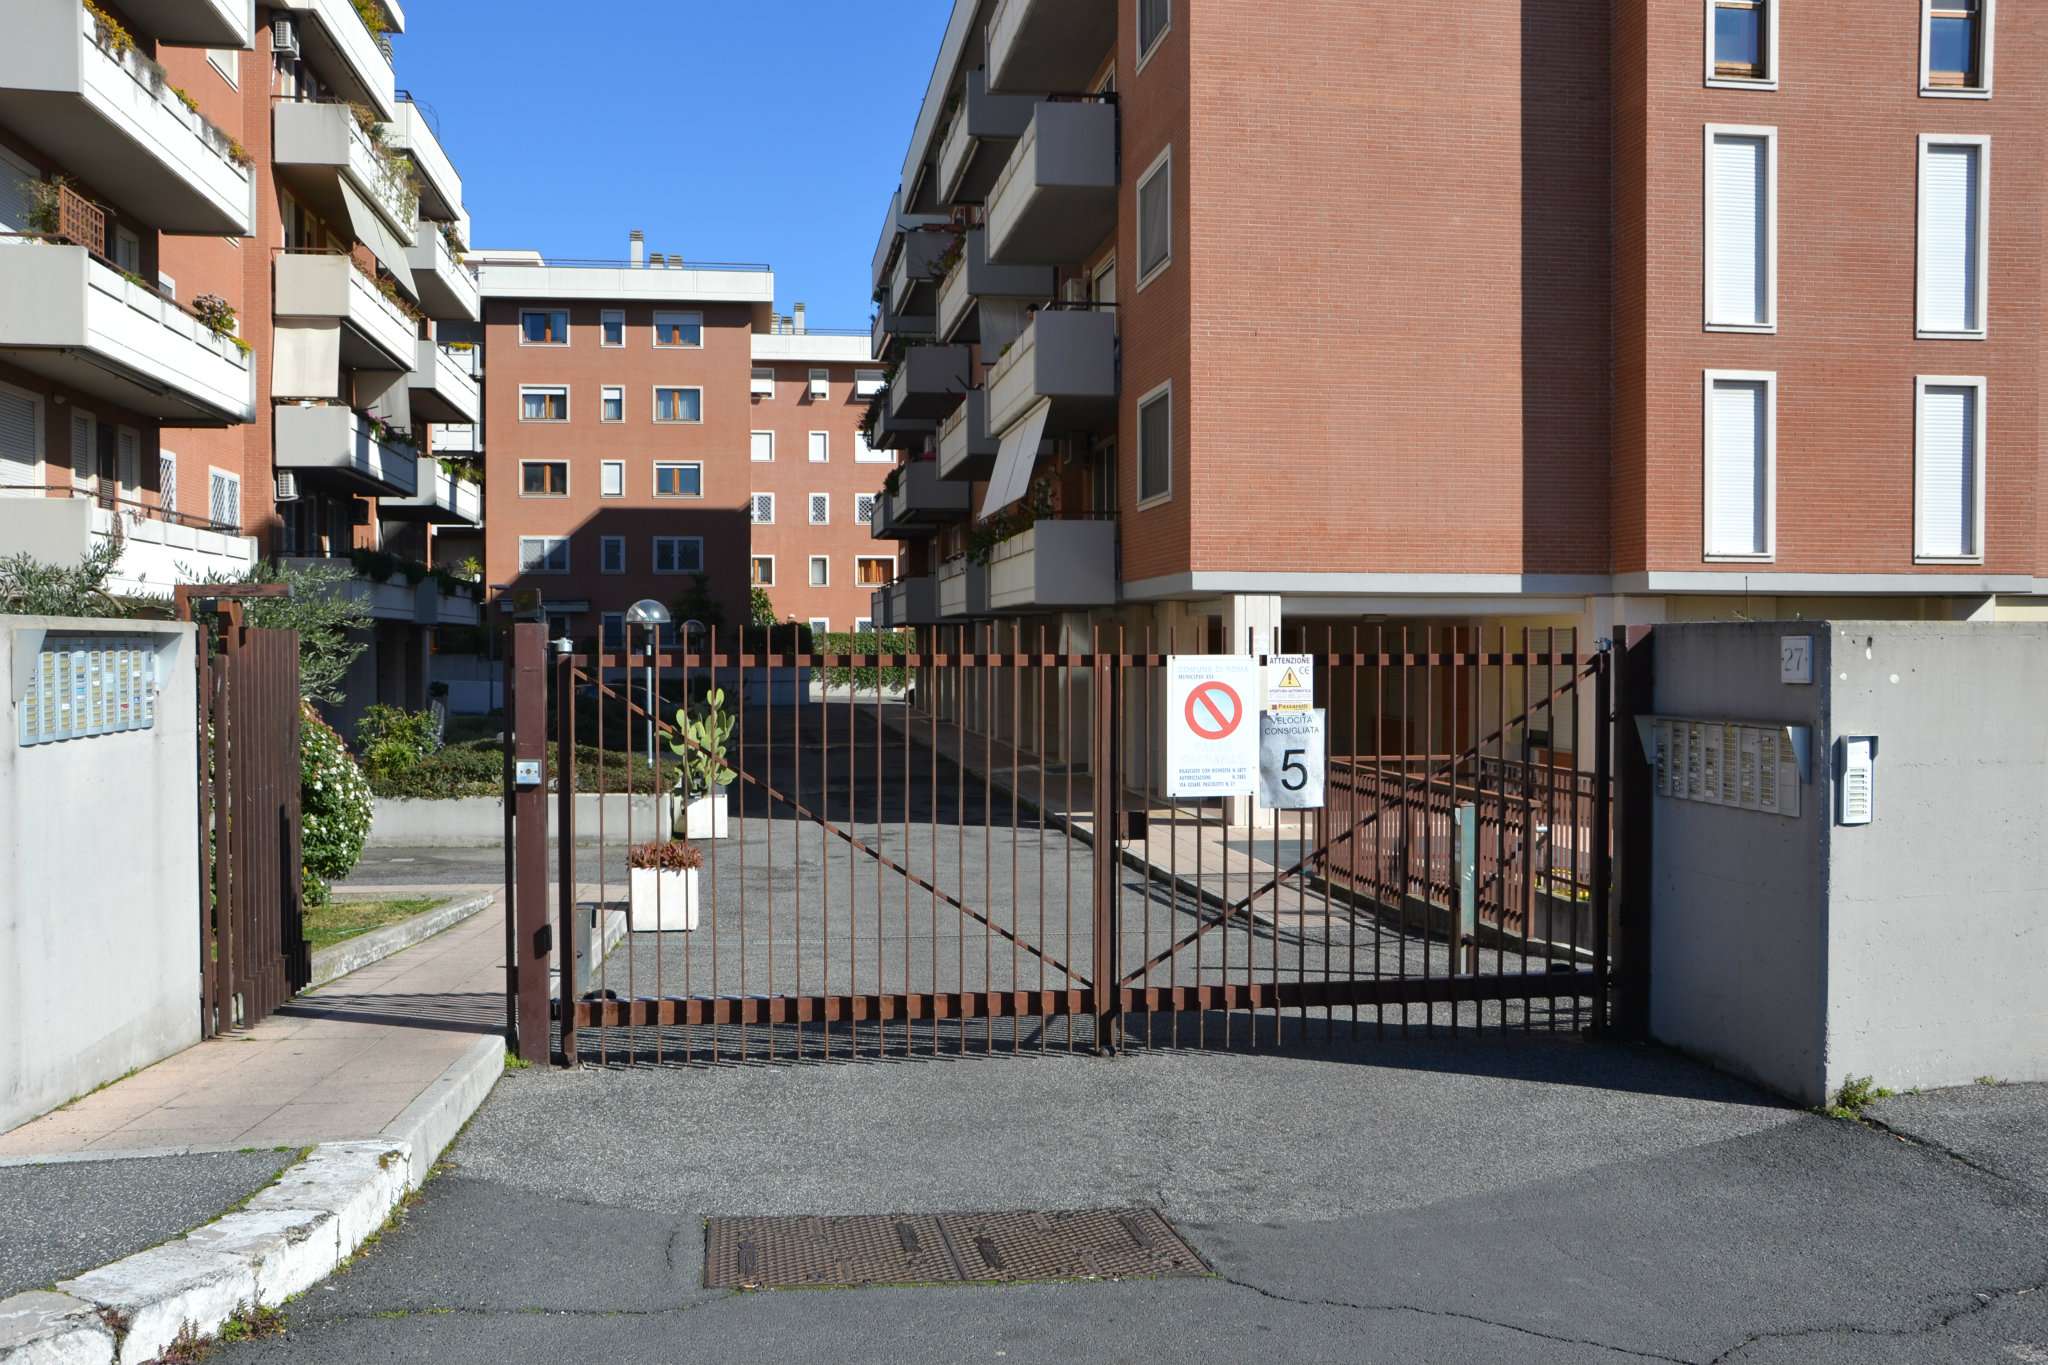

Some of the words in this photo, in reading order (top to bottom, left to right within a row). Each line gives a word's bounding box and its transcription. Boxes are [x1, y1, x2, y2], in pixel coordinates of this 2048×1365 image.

[1269, 657, 1311, 665] ATTENZIONE
[1783, 647, 1804, 672] 27
[1264, 726, 1320, 736] CONSIGLIATA
[1281, 748, 1308, 791] 5
